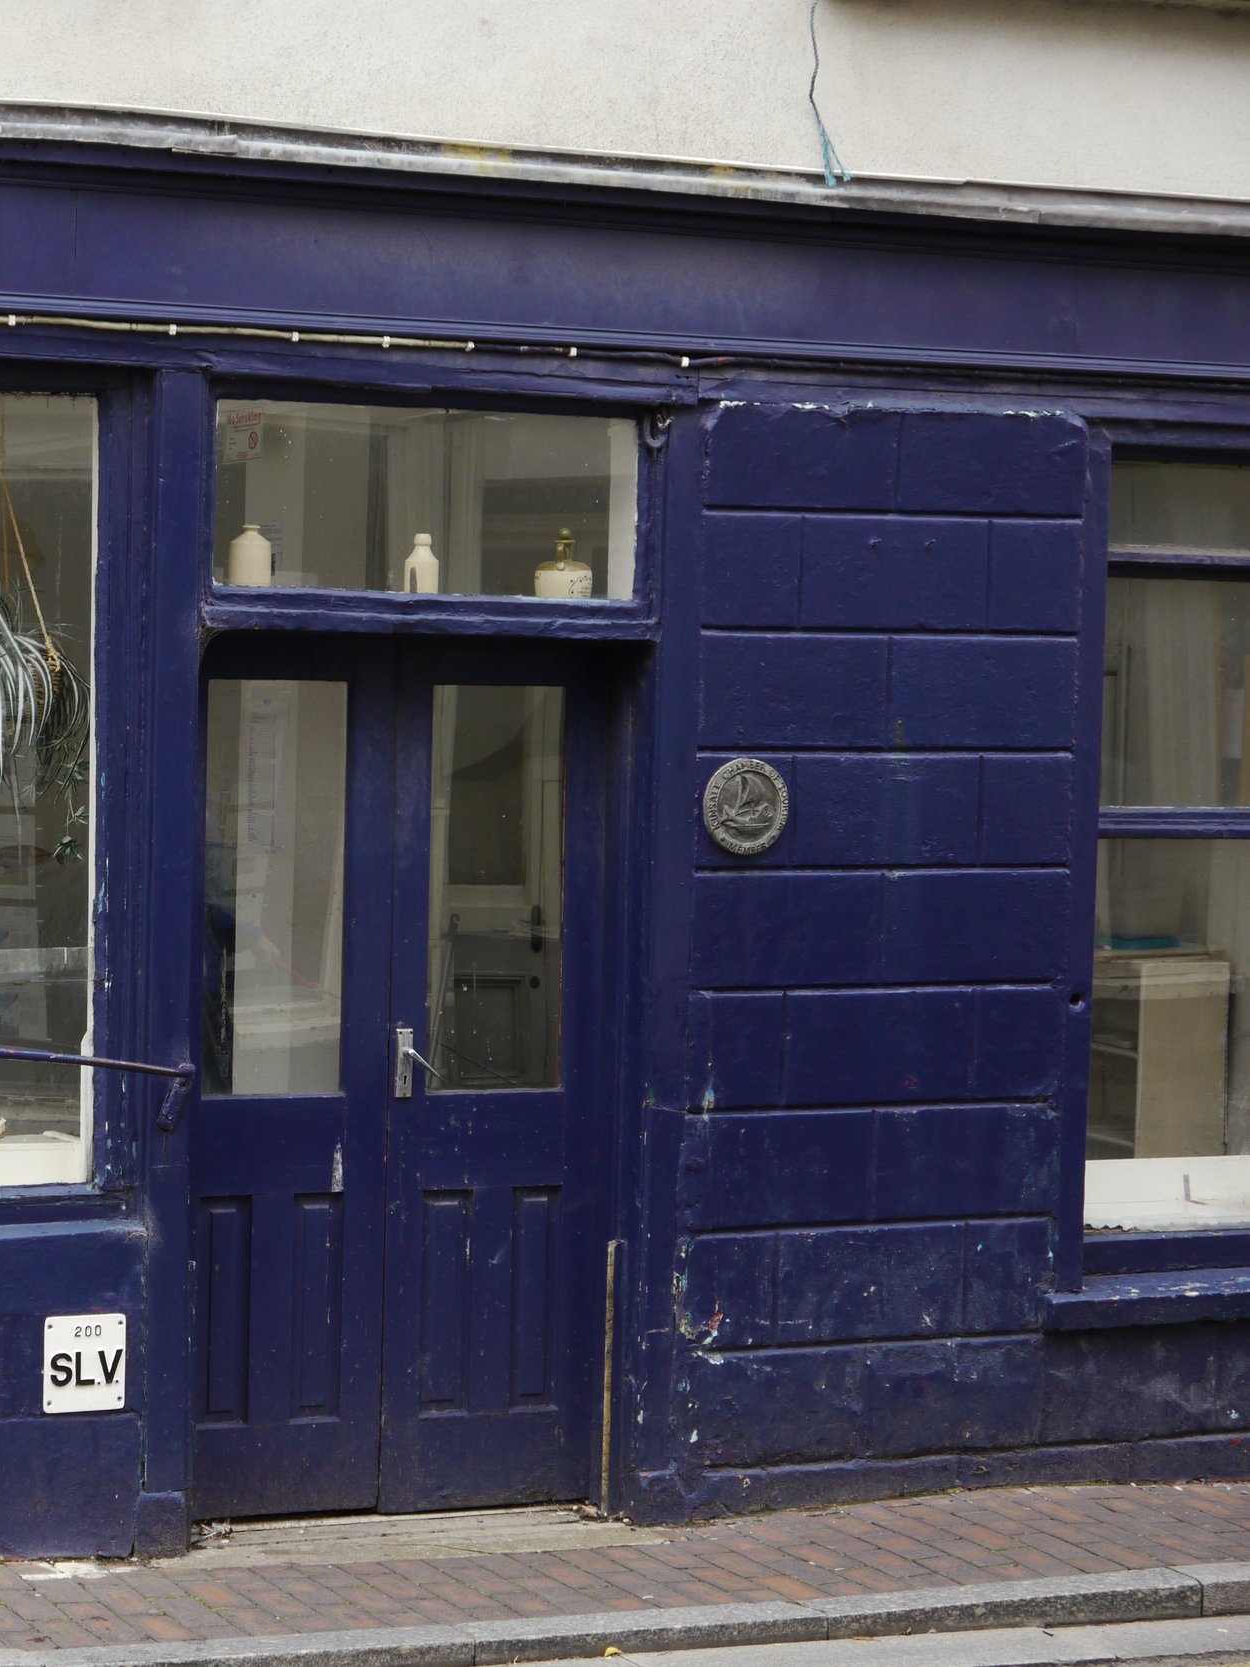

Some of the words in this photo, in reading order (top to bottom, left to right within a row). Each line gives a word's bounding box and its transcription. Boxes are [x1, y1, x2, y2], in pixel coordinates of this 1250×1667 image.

[236, 411, 262, 425] Smoking
[722, 760, 767, 781] CHAMBER
[768, 768, 780, 782] OF
[726, 842, 769, 855] MEMBER
[74, 1325, 102, 1338] 200
